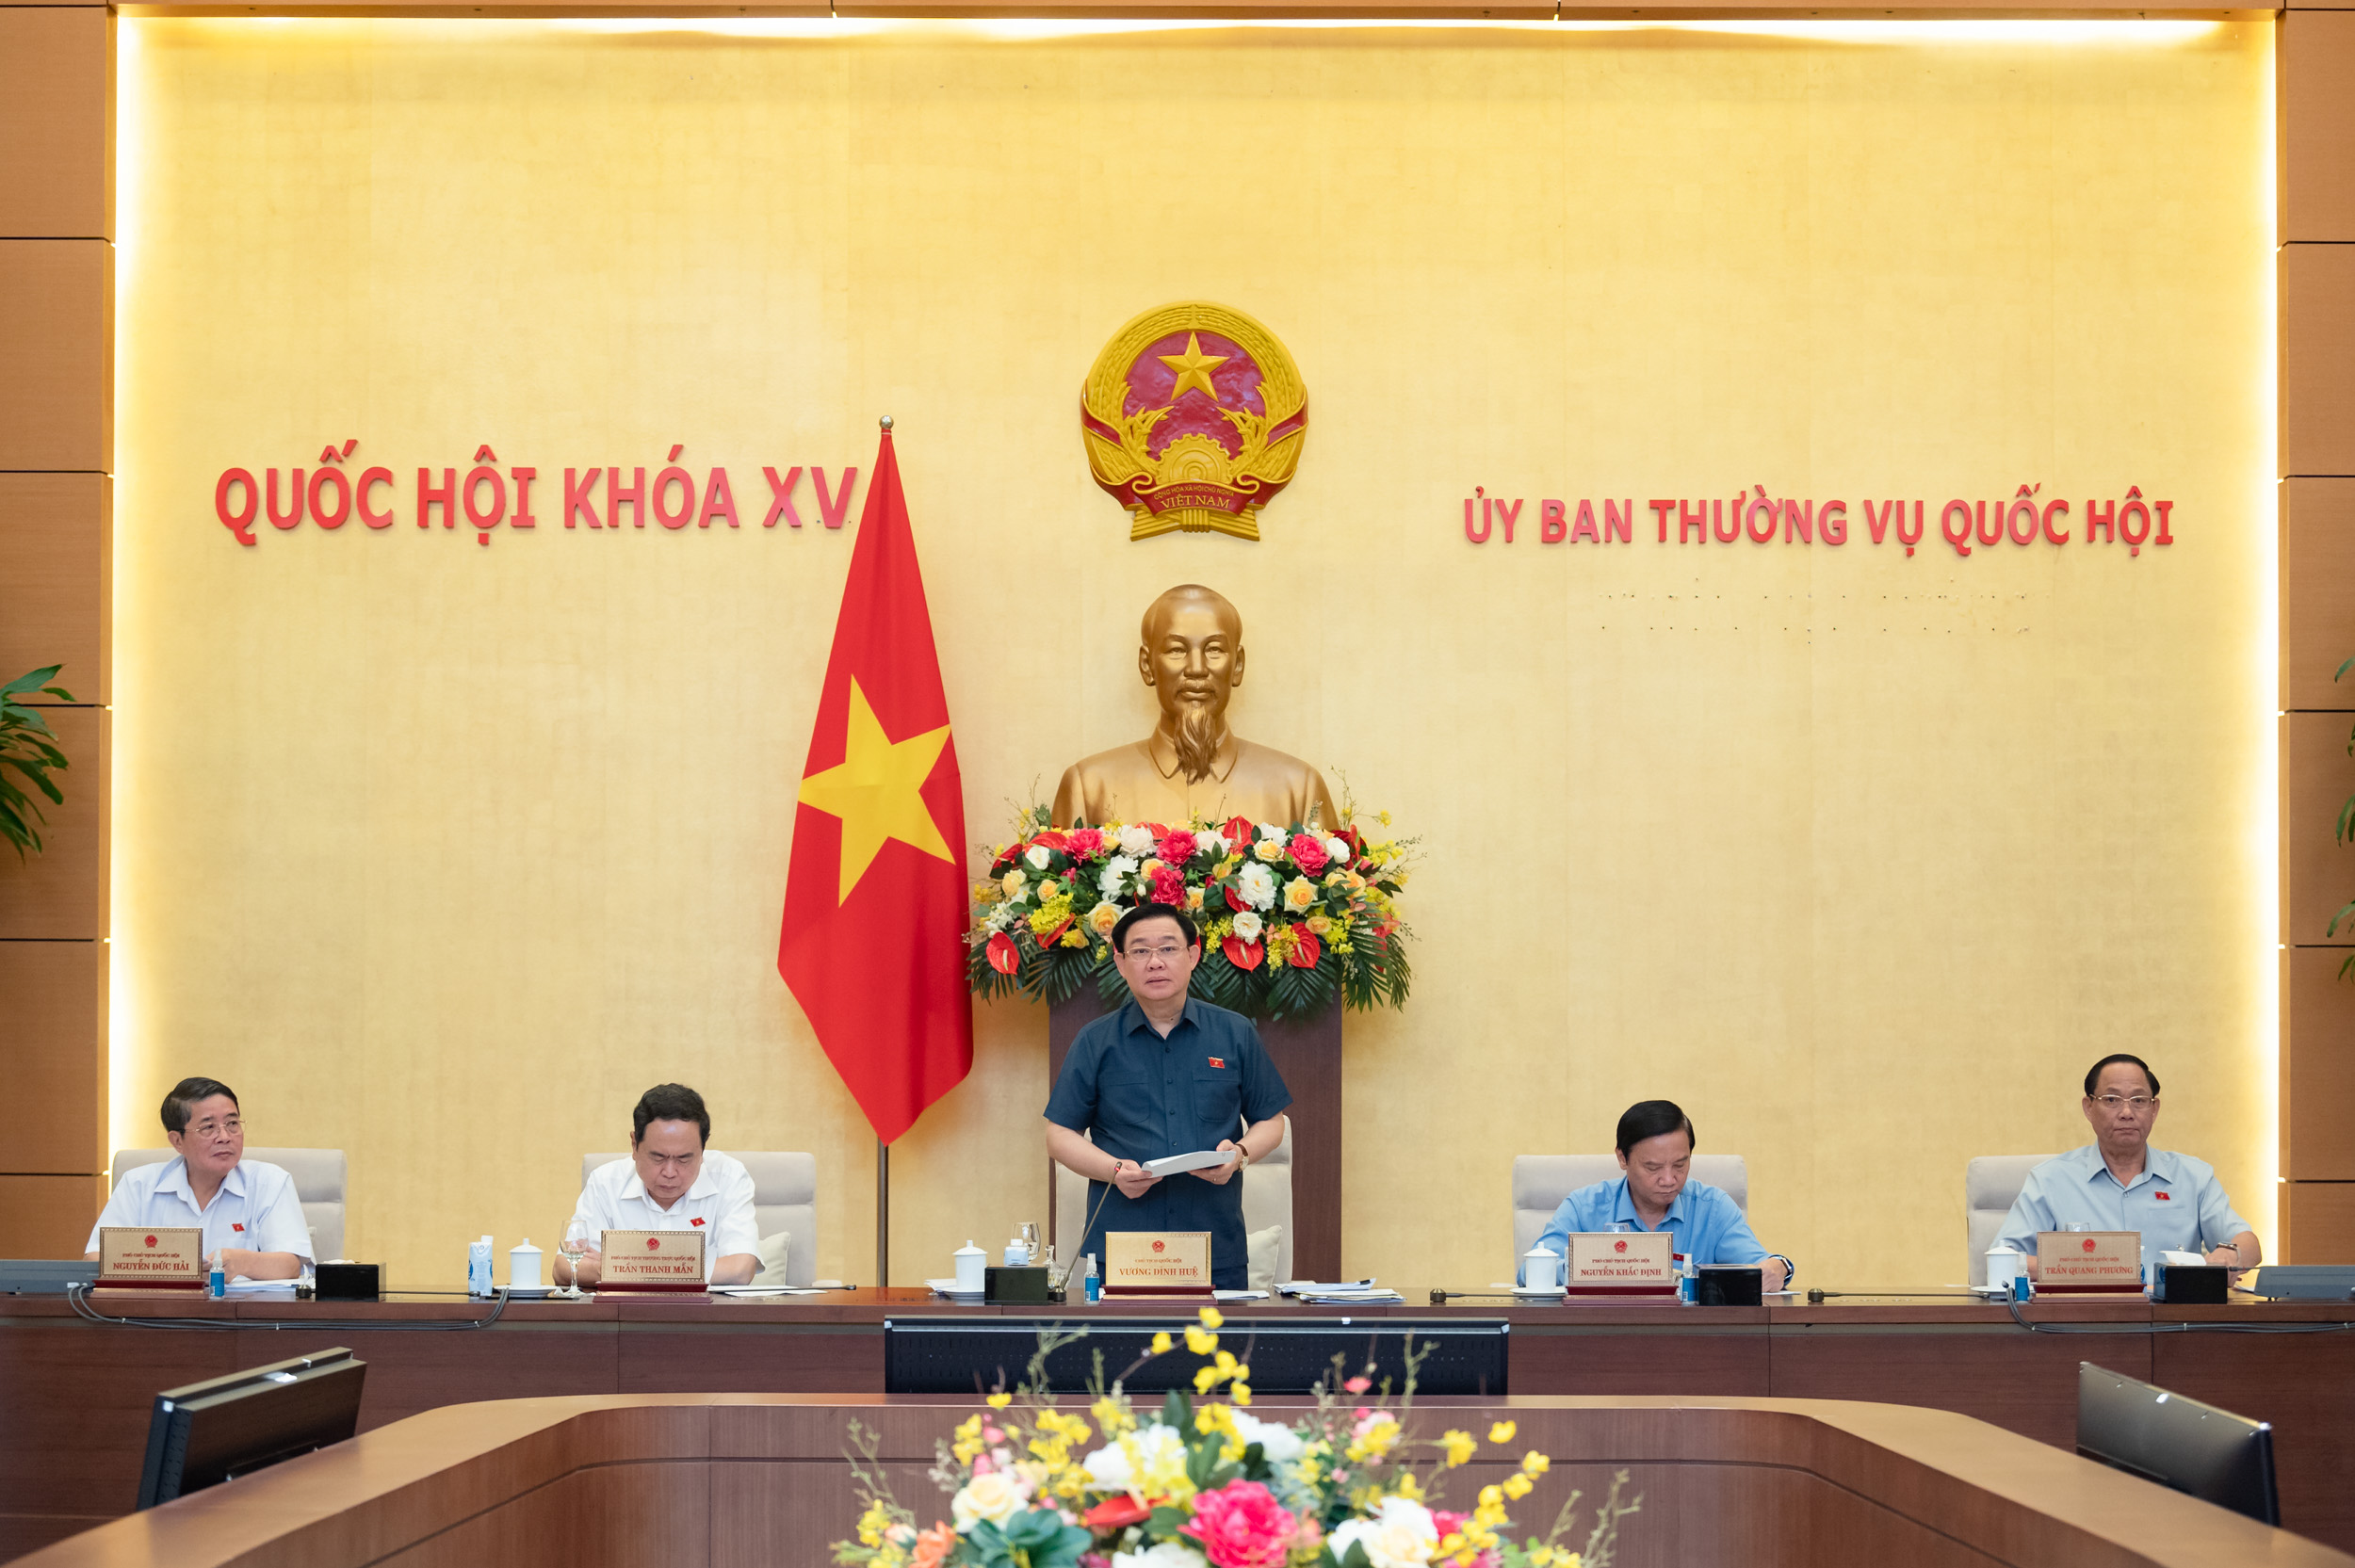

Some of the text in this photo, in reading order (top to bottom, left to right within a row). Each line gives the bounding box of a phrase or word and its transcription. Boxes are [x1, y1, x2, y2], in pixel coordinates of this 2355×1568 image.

[215, 439, 857, 547] QUỐC HỘI KHÓA XV
[1195, 495, 1230, 509] NAM
[1464, 482, 2173, 557] ỦY BAN THƯỜNG VỤ QUỐC HỘI
[113, 1259, 189, 1270] NGUYỄN ĐỨC HẢI
[640, 1265, 671, 1273] THANH
[1119, 1267, 1151, 1275] VƯƠNG
[1178, 1266, 1198, 1277] HUỆ
[1581, 1266, 1662, 1277] NGUYỄN KHẮC ĐỊNH
[2069, 1267, 2097, 1275] QUANG
[2099, 1266, 2134, 1274] PHƯƠNG
